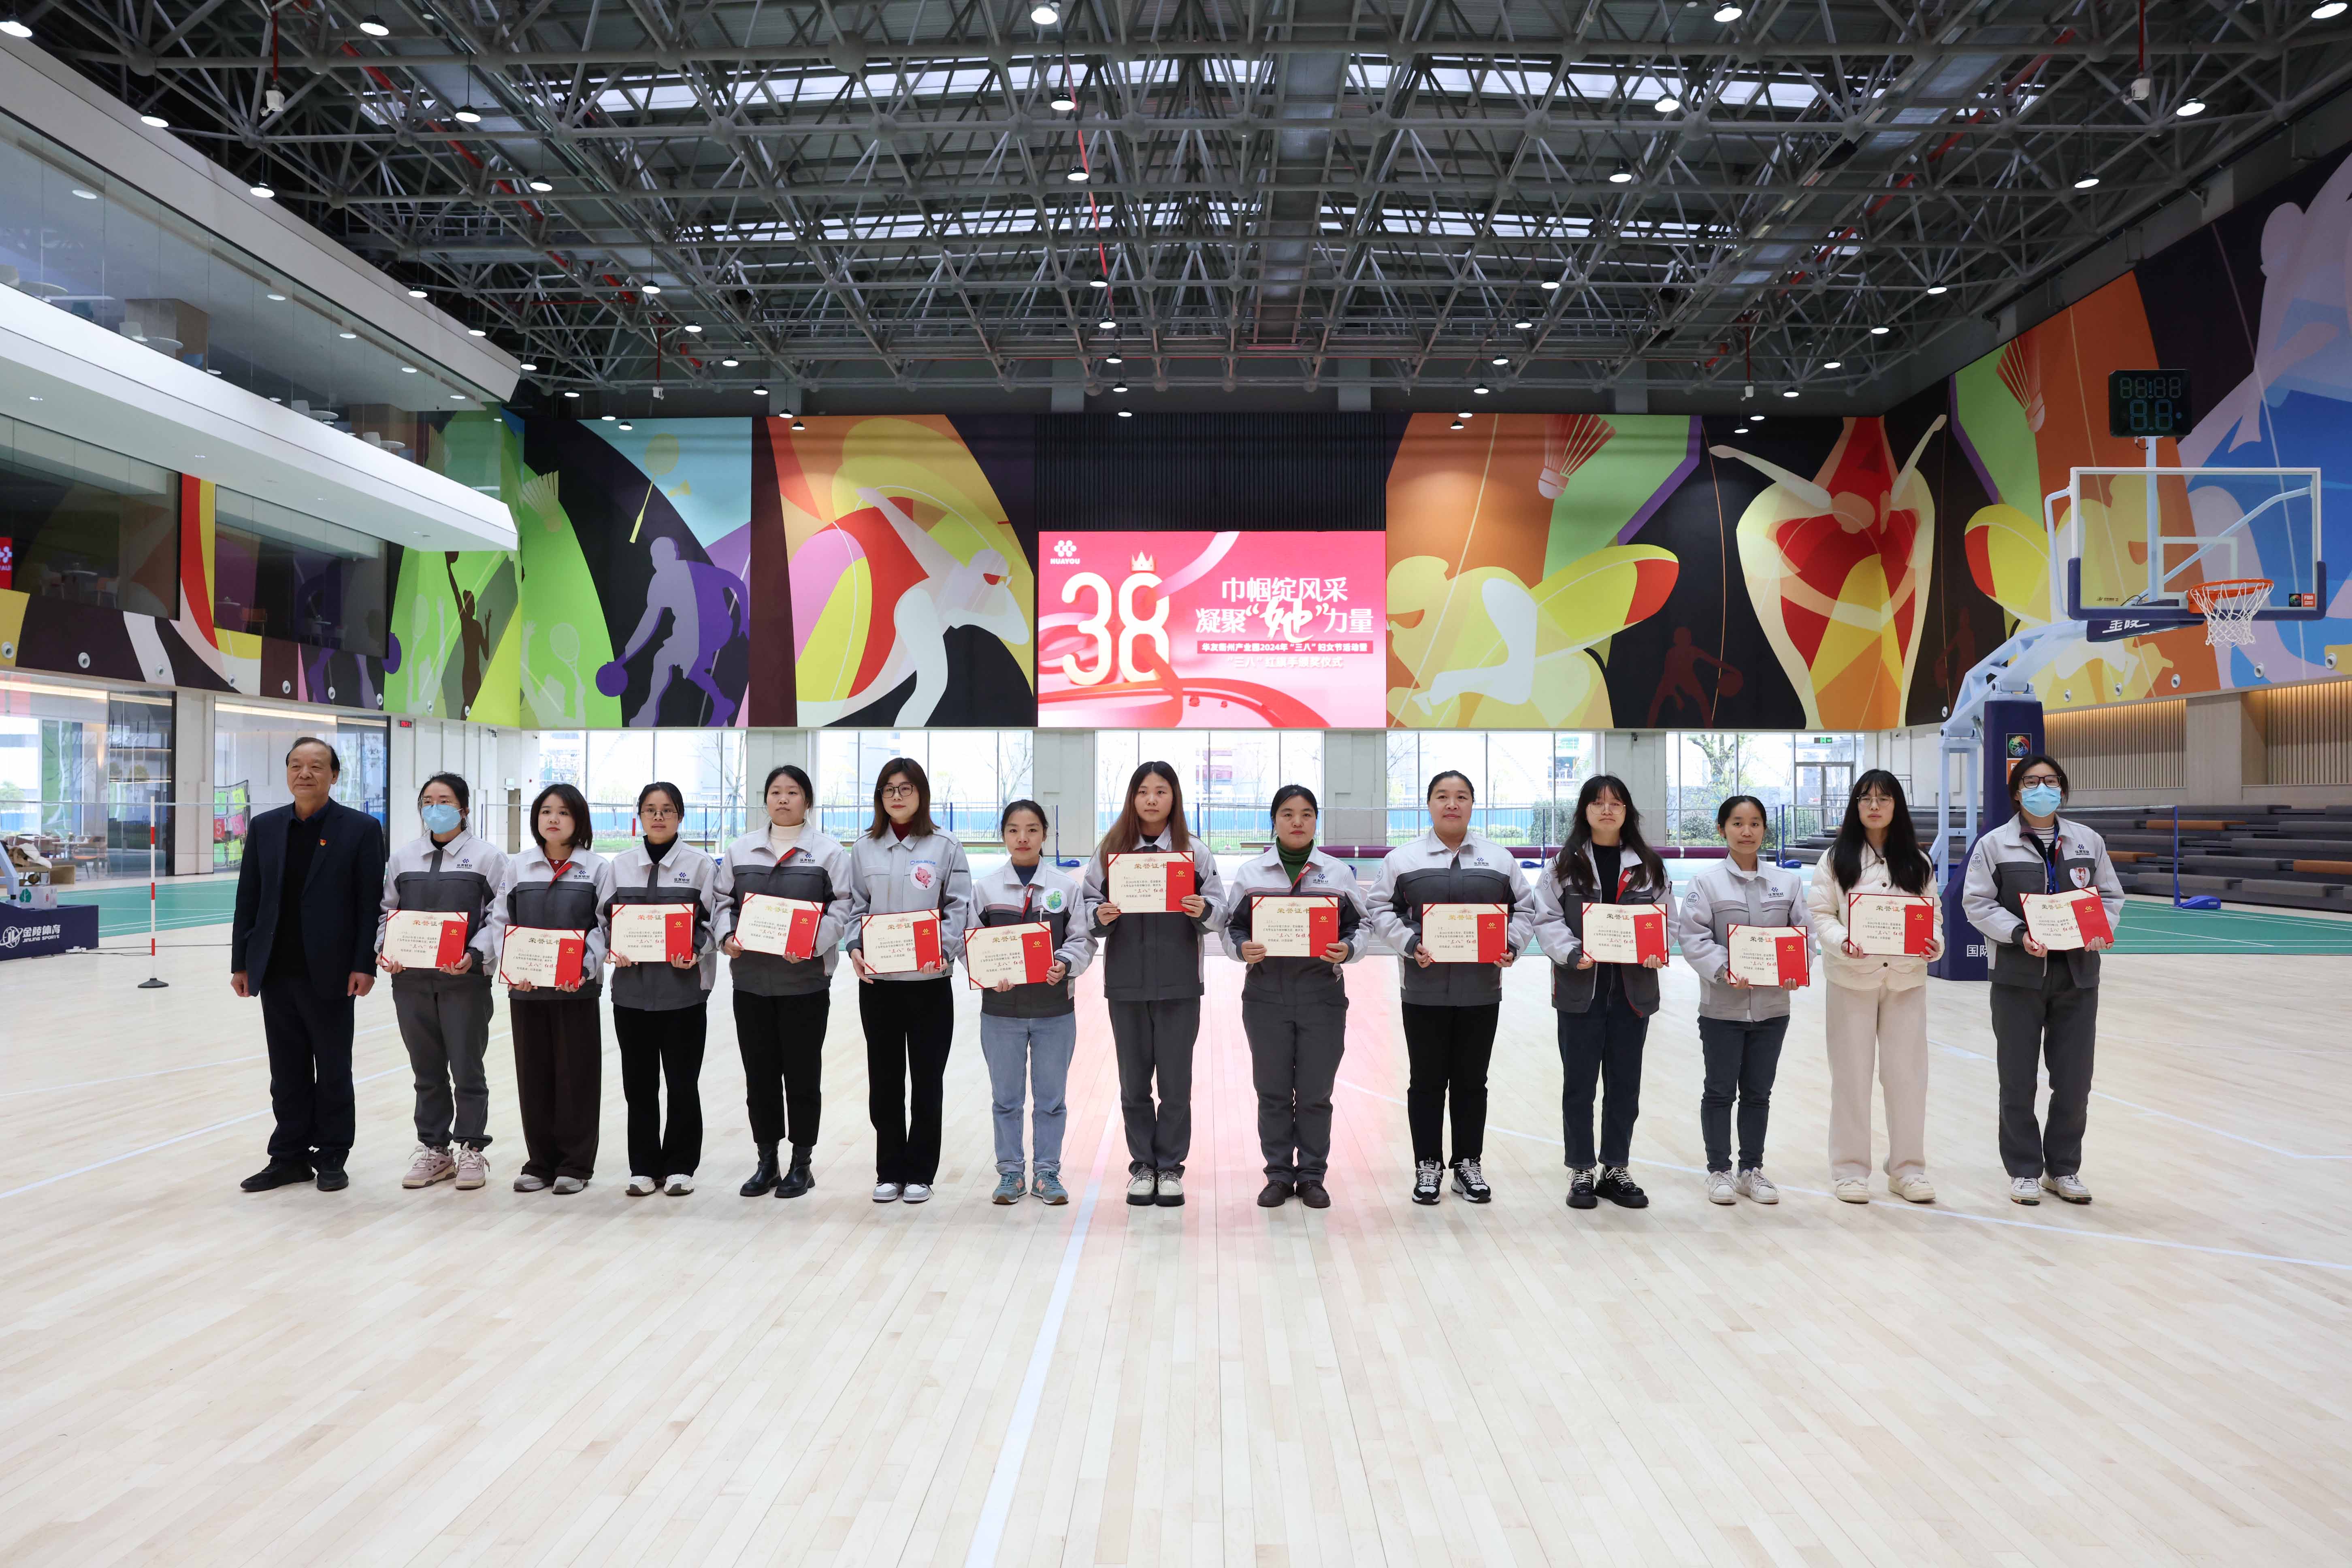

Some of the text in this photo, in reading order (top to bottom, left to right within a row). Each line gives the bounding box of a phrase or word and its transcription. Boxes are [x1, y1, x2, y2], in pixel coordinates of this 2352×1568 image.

[1222, 577, 1348, 602] 巾帼绽风采
[1061, 572, 1170, 685] 38
[216, 821, 222, 835] 5
[22, 924, 61, 937] 金陵体育
